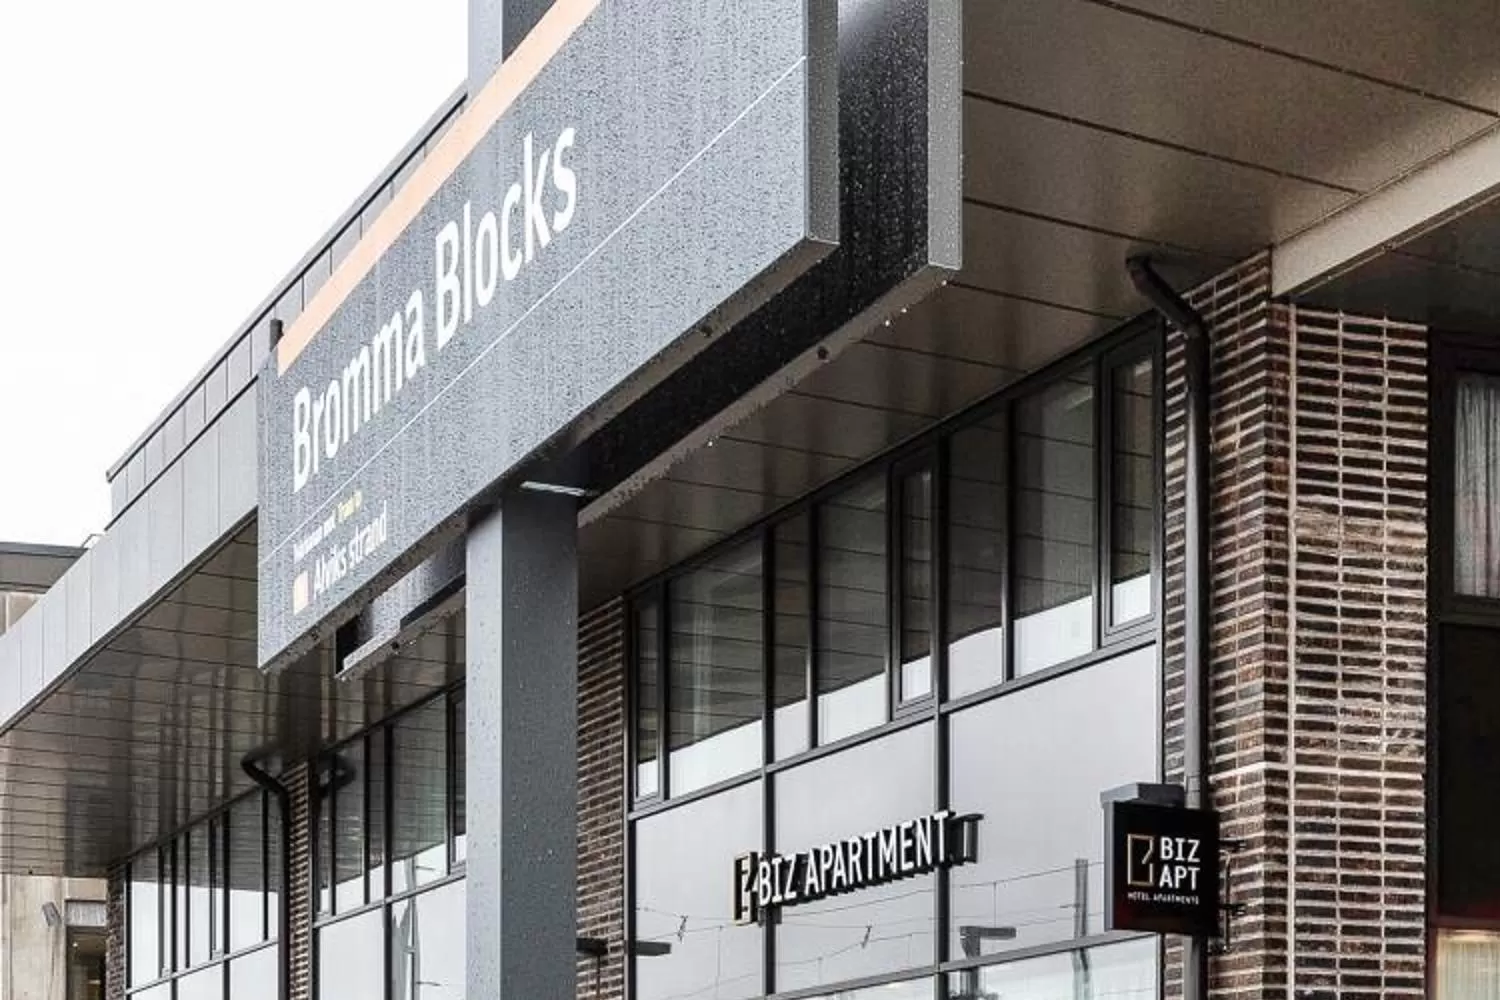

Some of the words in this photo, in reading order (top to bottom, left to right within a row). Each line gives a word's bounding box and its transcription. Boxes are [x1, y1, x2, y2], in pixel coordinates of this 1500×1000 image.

[293, 288, 426, 493] Bromma
[435, 127, 577, 351] Blocks
[758, 855, 797, 907] BIZ
[804, 810, 949, 896] APARTMENT
[1159, 864, 1200, 891] APT
[1160, 836, 1200, 863] BIZ
